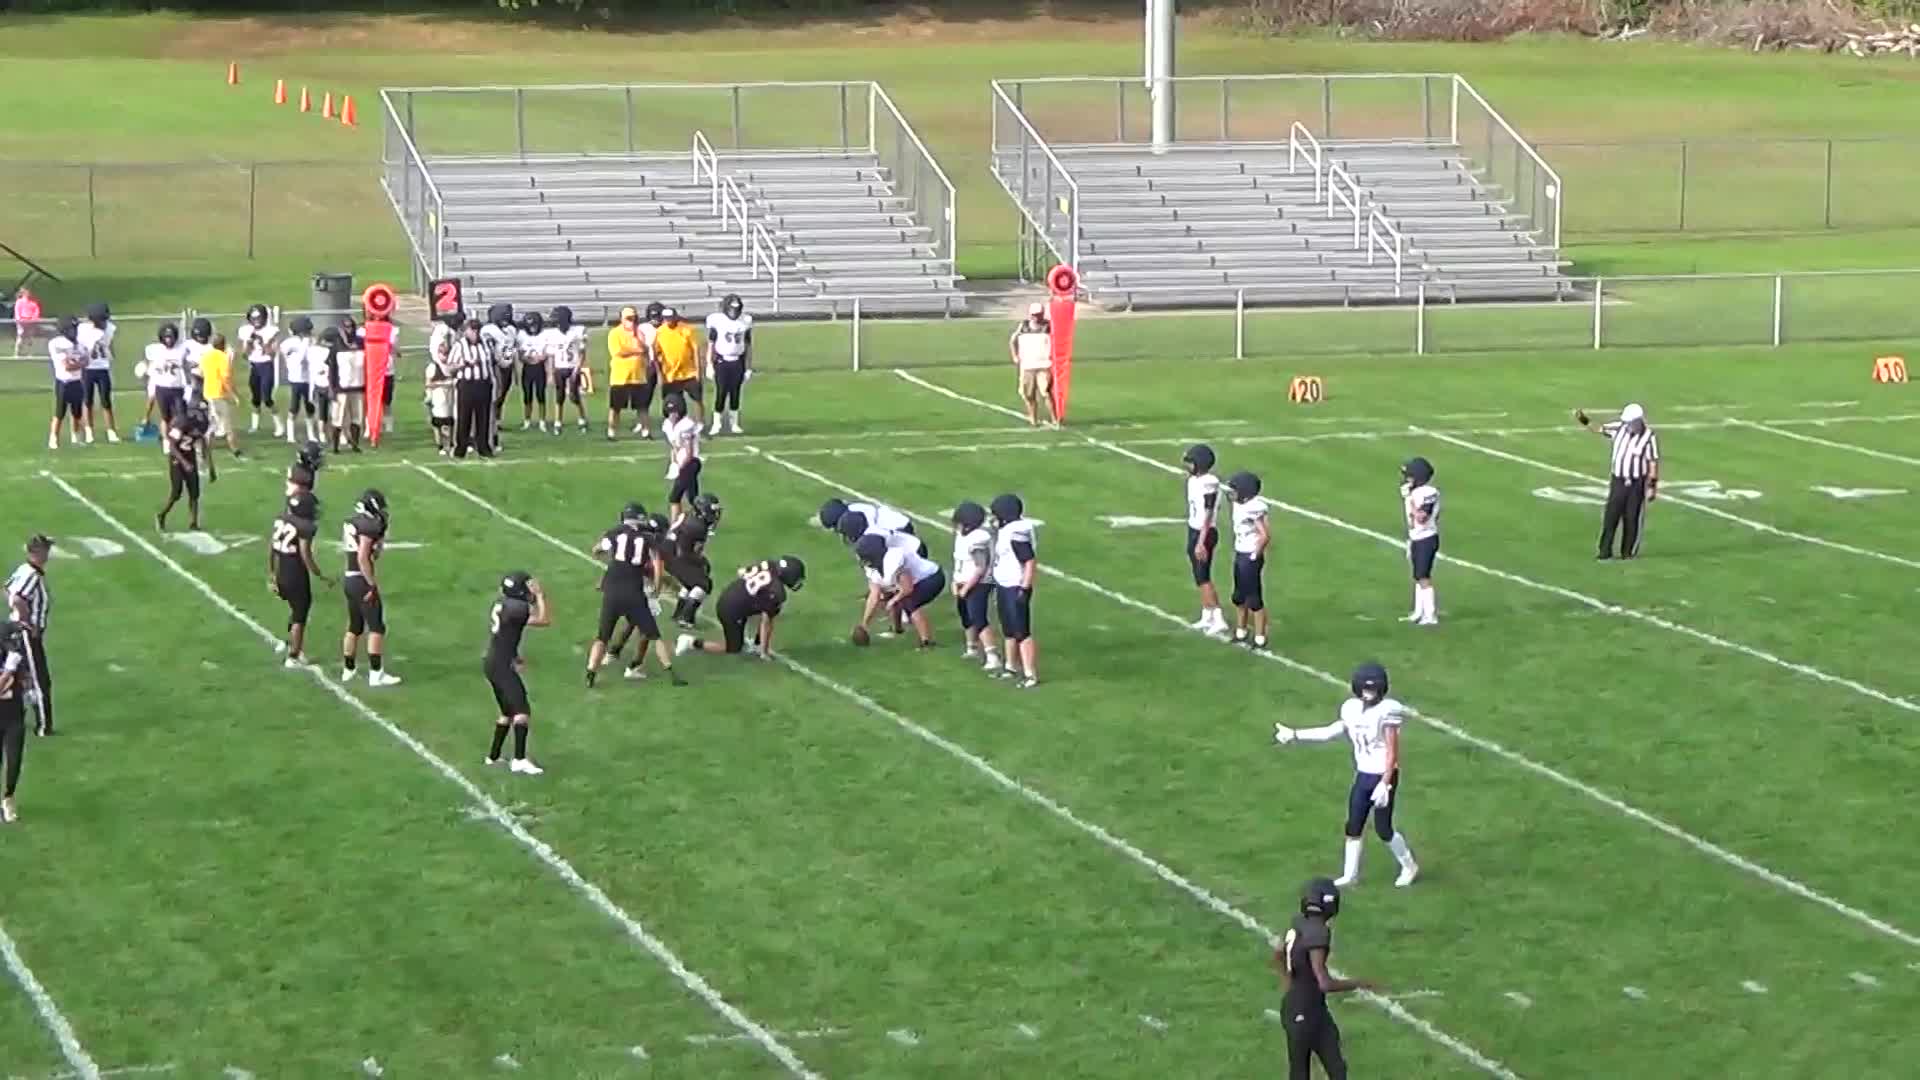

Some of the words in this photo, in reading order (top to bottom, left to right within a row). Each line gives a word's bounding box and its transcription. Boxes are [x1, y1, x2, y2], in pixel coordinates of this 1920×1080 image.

[434, 282, 459, 313] 2
[1299, 380, 1319, 400] 20
[272, 519, 297, 553] 22
[615, 533, 644, 566] 11
